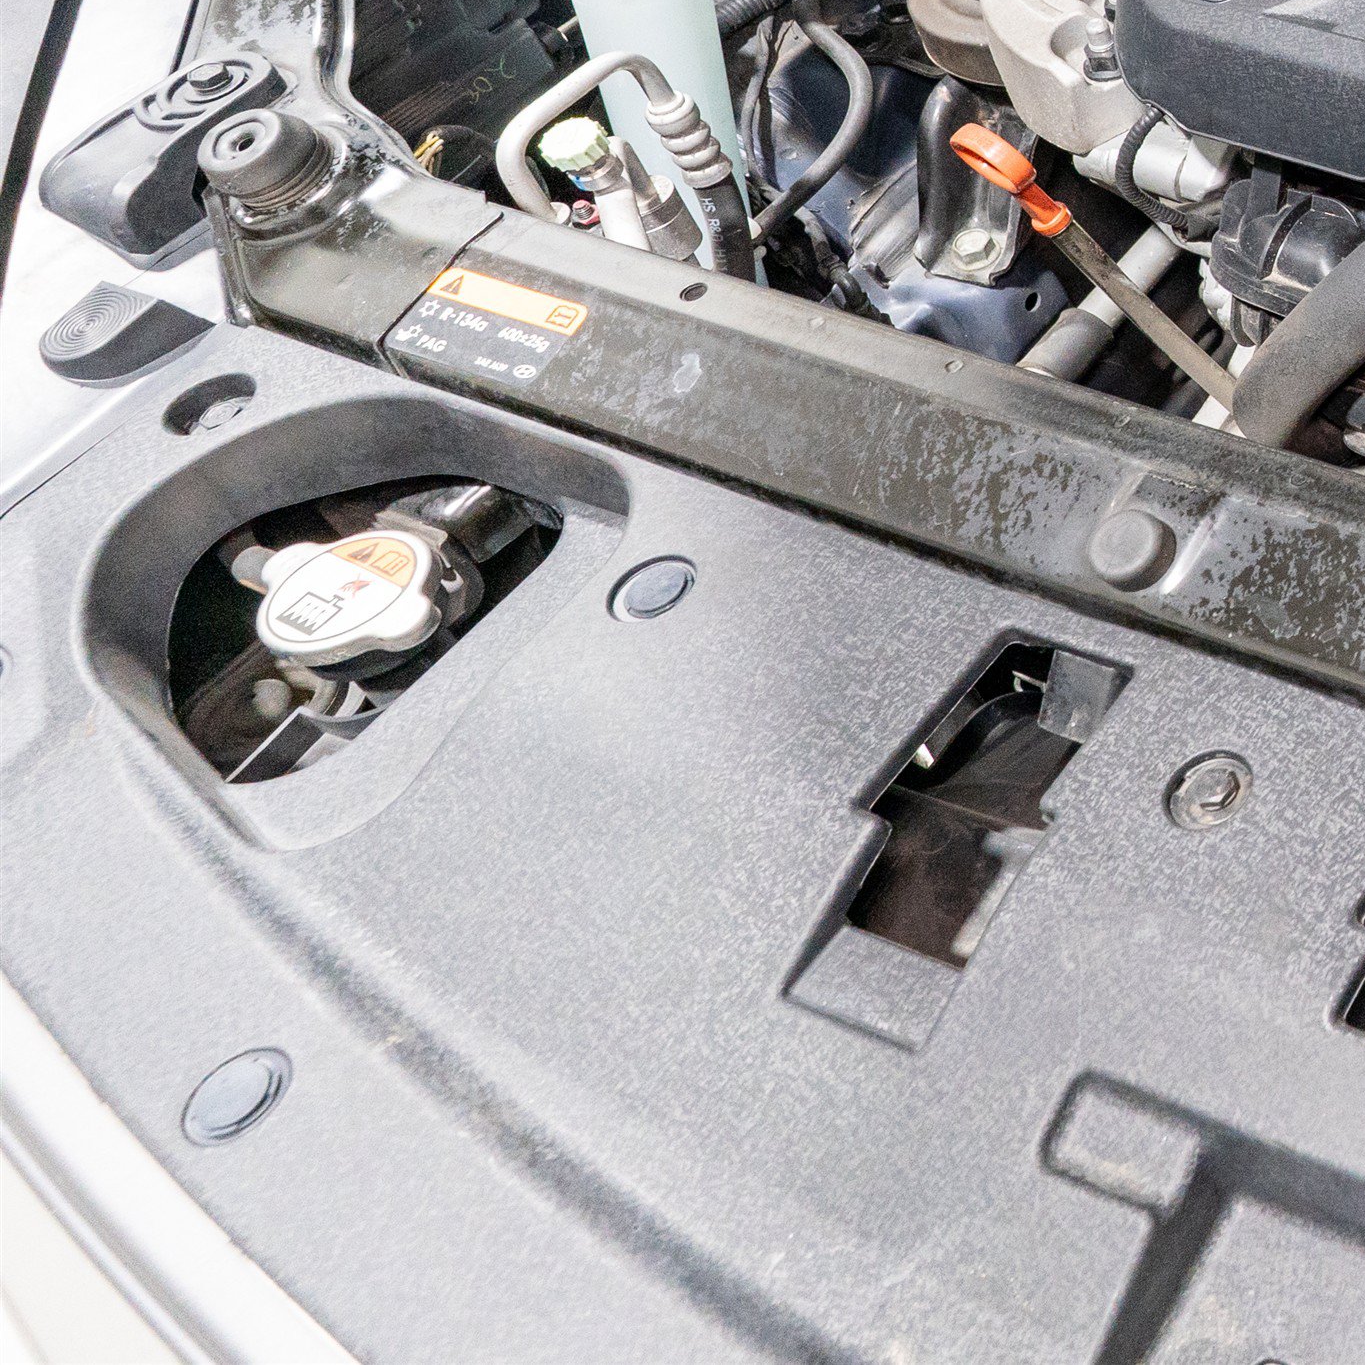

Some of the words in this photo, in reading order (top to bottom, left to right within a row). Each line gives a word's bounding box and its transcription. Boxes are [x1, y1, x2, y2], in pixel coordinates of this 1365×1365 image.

[700, 197, 717, 213] HS
[439, 307, 489, 332] R-134a
[416, 334, 448, 352] PAG
